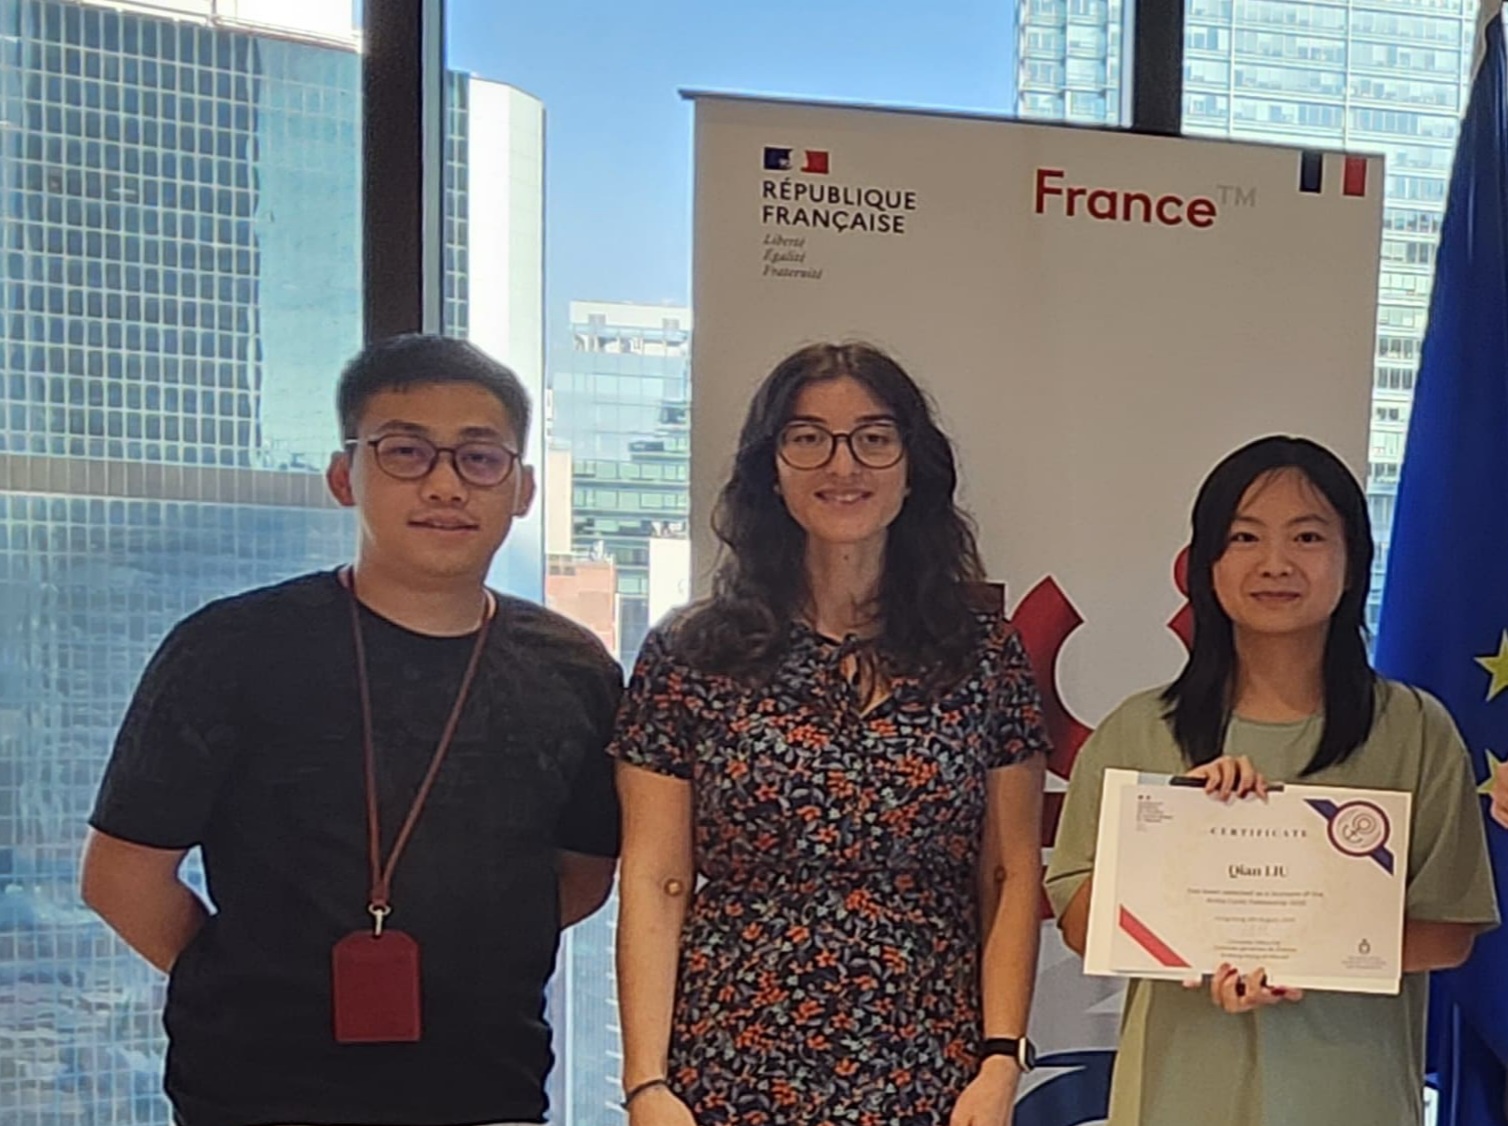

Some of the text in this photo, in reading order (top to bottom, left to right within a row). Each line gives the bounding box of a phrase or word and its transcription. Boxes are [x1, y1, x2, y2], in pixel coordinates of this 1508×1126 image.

[763, 177, 916, 211] RÉPUBLIQUE
[763, 205, 905, 234] FRANÇAISE
[1210, 826, 1307, 838] CERTIFICATE
[1228, 864, 1261, 879] Qian
